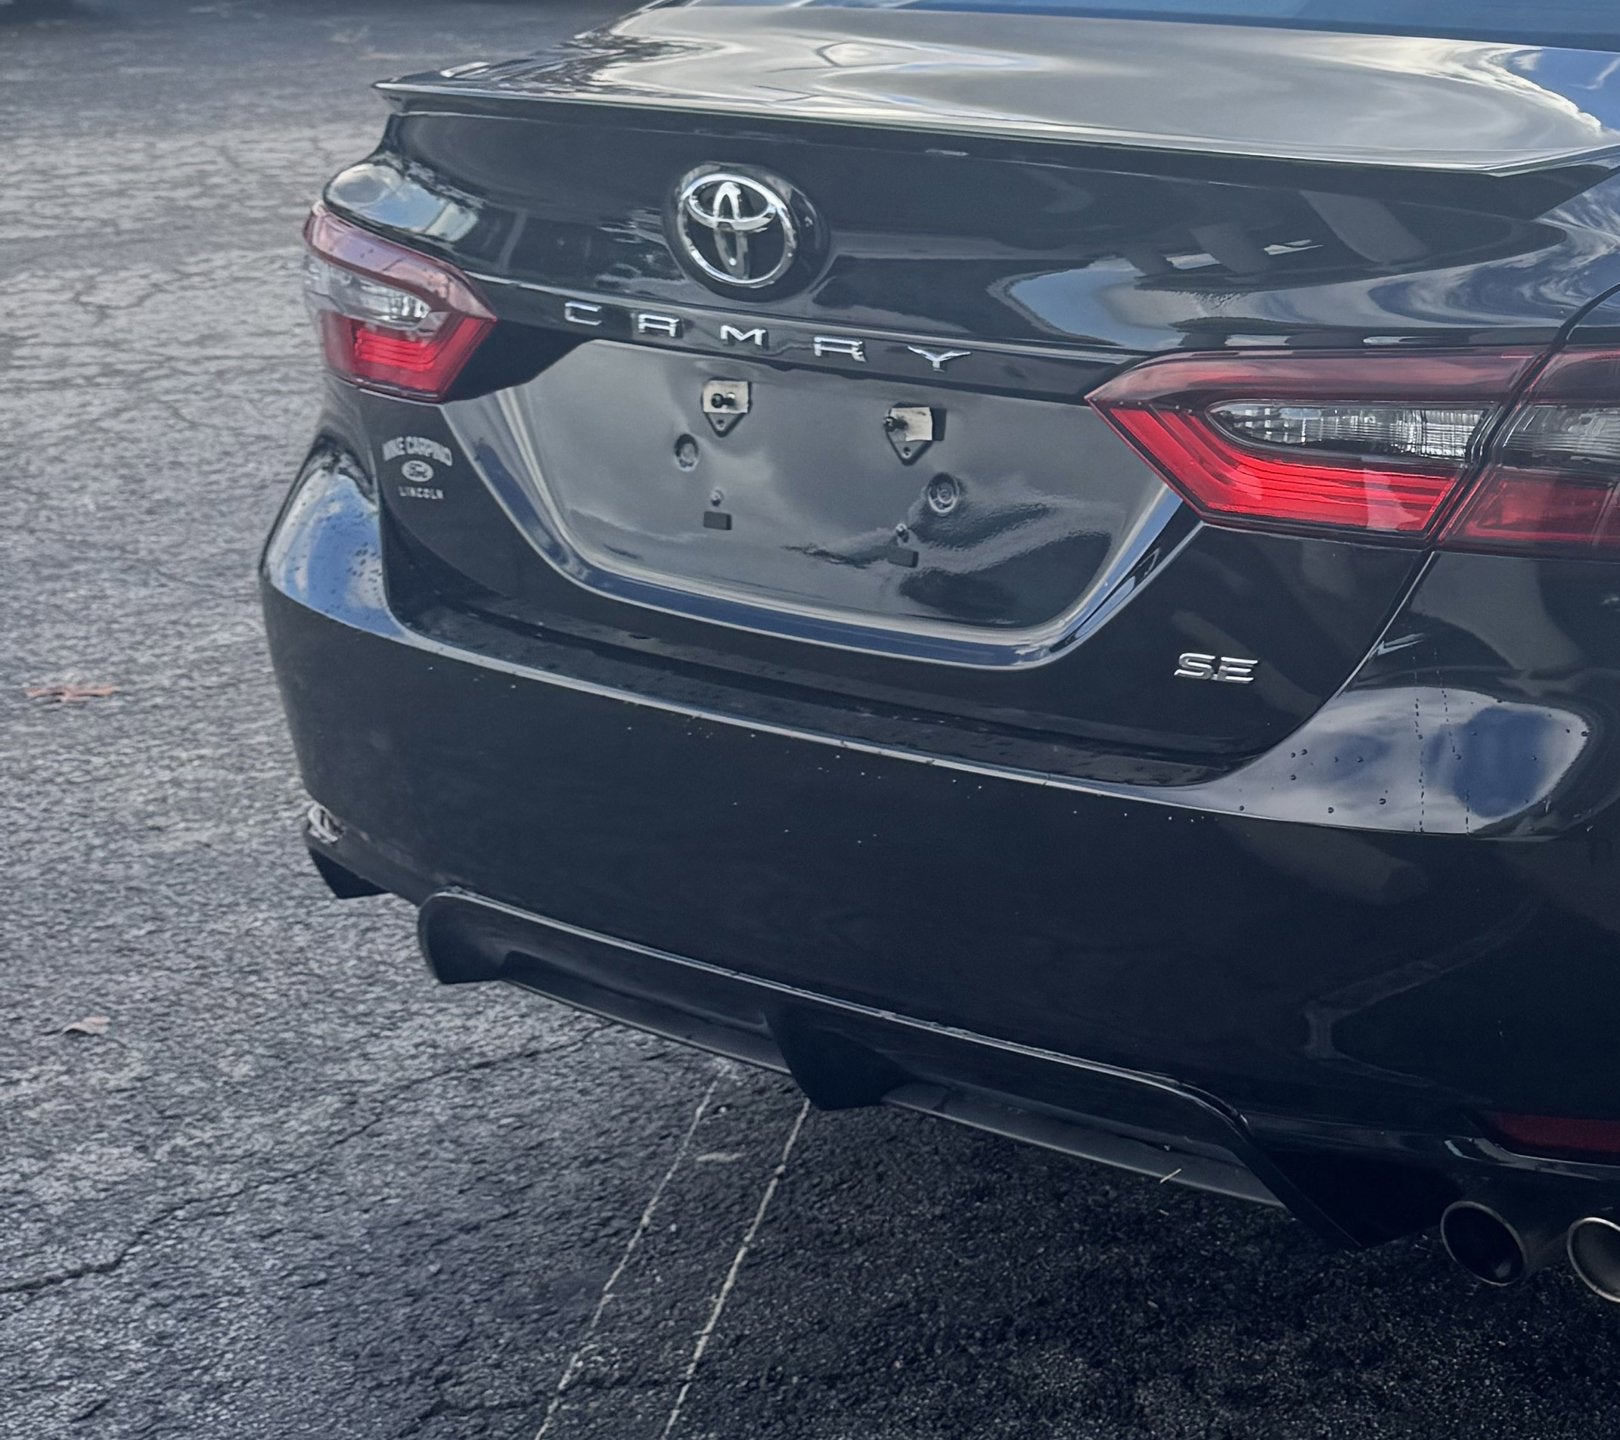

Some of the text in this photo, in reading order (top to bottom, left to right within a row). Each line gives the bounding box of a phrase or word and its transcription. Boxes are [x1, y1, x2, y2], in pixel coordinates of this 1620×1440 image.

[564, 301, 971, 372] CAMRY
[398, 487, 444, 500] LINCOLN
[1174, 652, 1259, 684] SE
